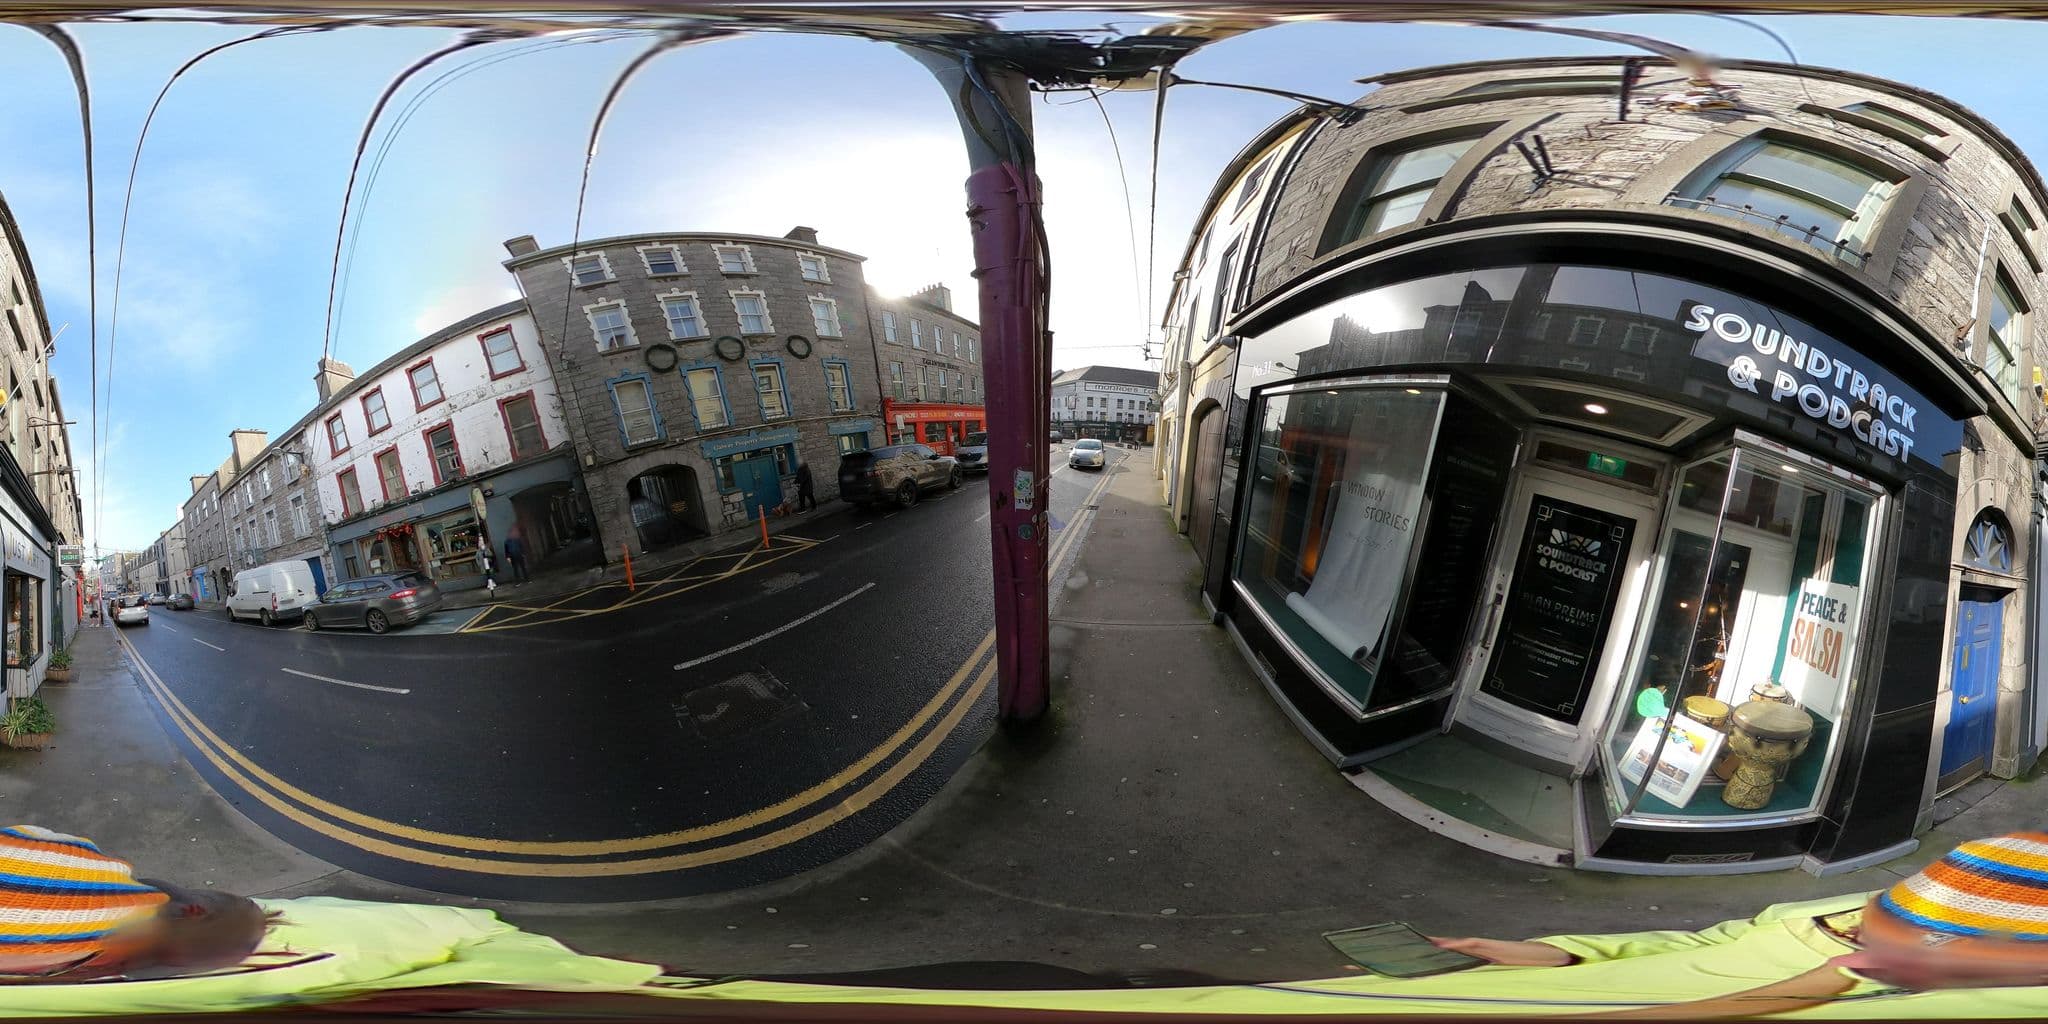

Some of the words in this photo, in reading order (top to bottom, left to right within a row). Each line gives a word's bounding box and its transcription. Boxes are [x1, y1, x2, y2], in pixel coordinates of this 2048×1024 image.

[1684, 305, 1917, 433] SOUNDTRACK
[1727, 355, 1762, 394] &
[1770, 369, 1914, 464] PODCAST
[1364, 506, 1410, 532] STORIES
[1536, 544, 1607, 574] SOUNDTRACK
[1539, 557, 1548, 568] &
[1549, 560, 1598, 583] PODCAST
[1800, 592, 1838, 622] PEACE
[1838, 603, 1848, 624] &
[1791, 618, 1843, 679] SALSA
